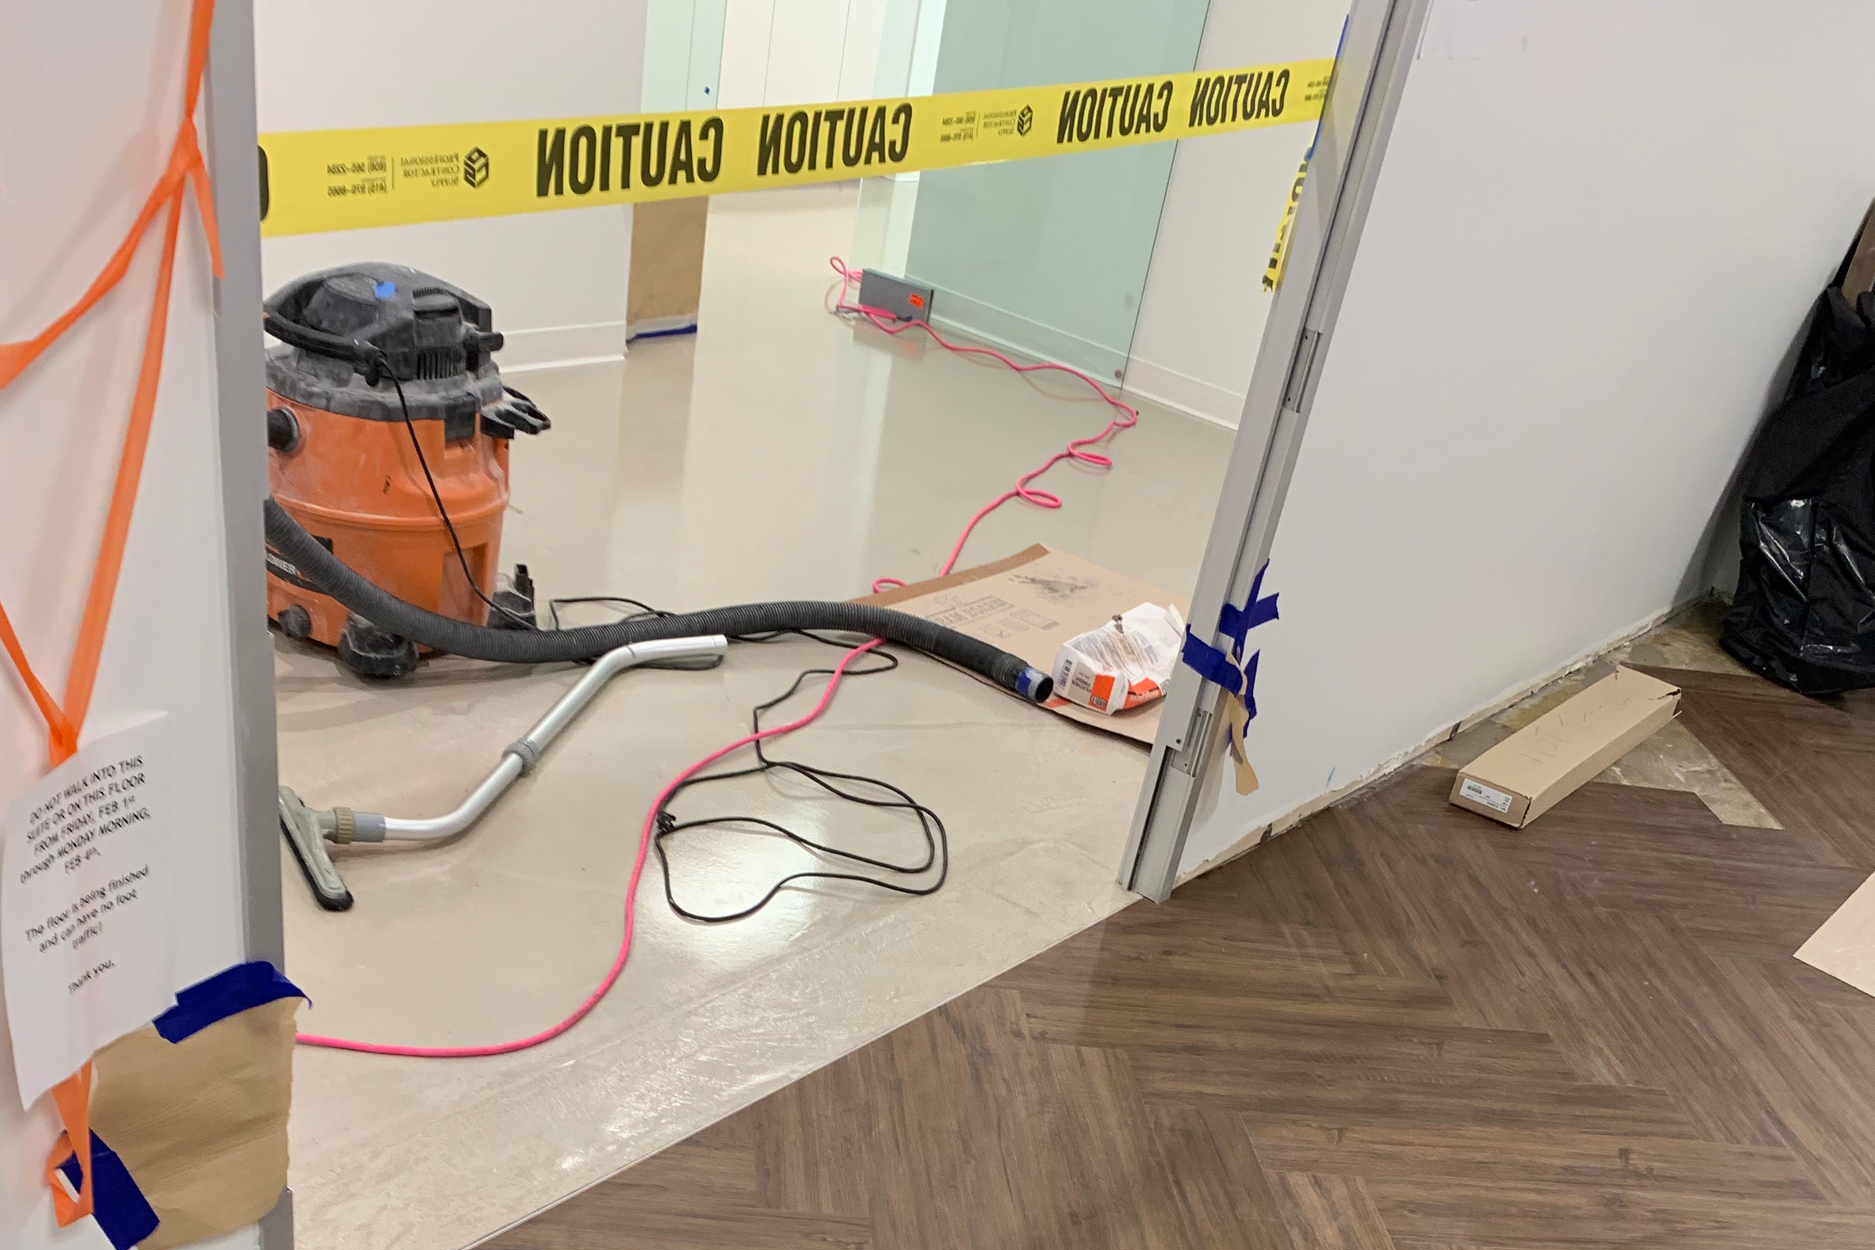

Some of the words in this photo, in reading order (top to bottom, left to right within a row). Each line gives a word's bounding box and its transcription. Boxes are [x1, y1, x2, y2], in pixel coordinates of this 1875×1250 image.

[26, 819, 50, 844] SUITE
[52, 808, 66, 826] OR
[66, 799, 82, 816] ON
[82, 787, 106, 806] THIS
[108, 772, 146, 796] FLOOR
[29, 807, 43, 825] DO
[43, 792, 63, 815] NOT
[63, 776, 89, 799] WALK
[90, 765, 117, 785] INTO
[118, 755, 144, 774] THIS
[20, 852, 55, 884] through
[56, 828, 97, 859] MONDAY
[33, 832, 59, 856] FROM
[98, 801, 119, 818] FEB
[64, 855, 82, 874] FEB
[25, 924, 45, 942] The
[46, 908, 70, 930] floor
[79, 887, 107, 909] being
[108, 864, 150, 893] finished
[39, 933, 58, 954] and
[76, 908, 98, 928] have
[100, 900, 114, 914] no
[116, 889, 138, 907] foot
[68, 969, 92, 995] Thank
